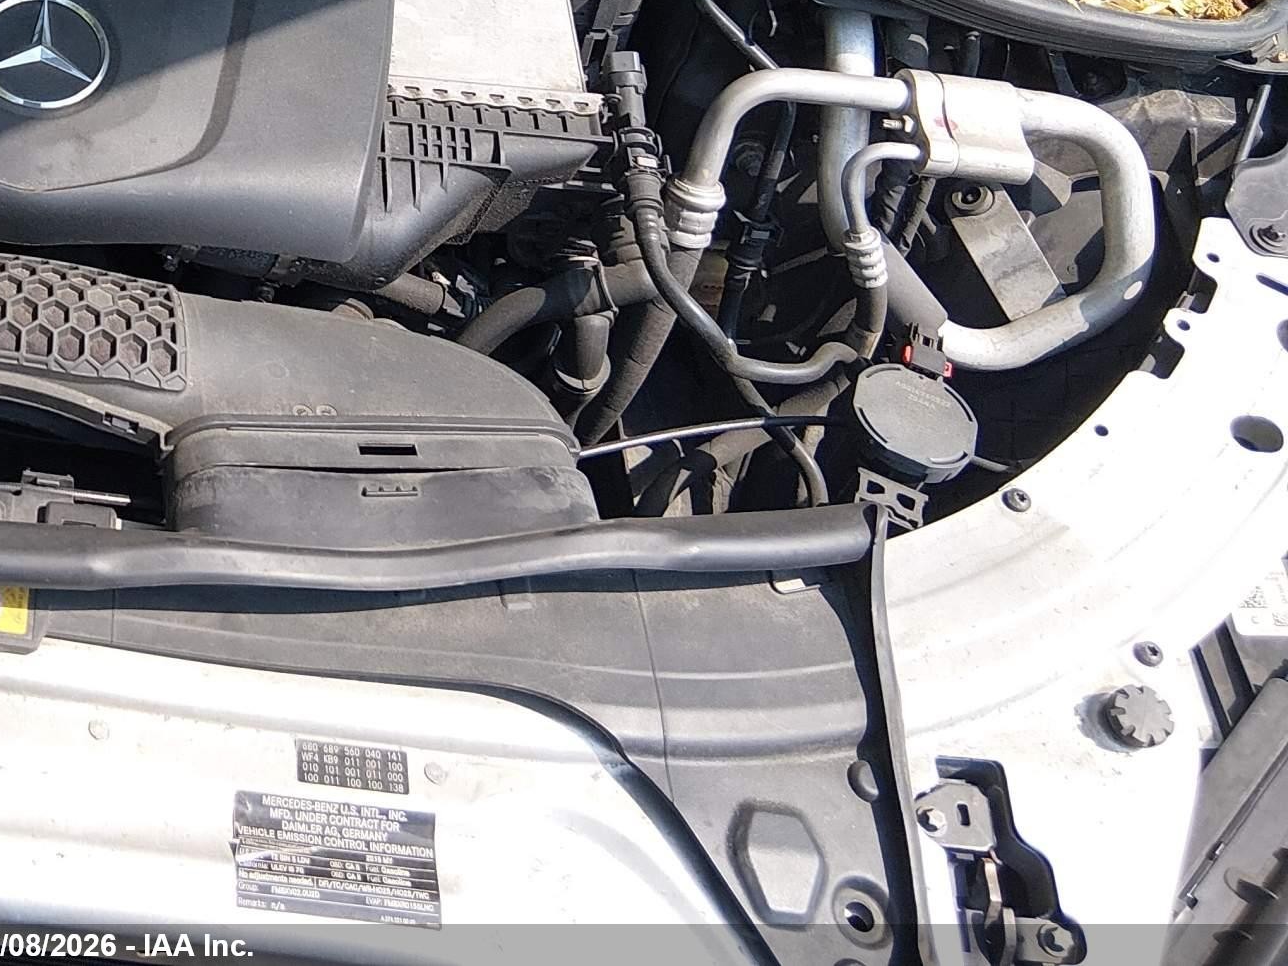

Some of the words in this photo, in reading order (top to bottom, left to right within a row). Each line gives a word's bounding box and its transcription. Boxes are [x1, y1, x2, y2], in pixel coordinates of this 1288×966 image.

[344, 757, 360, 766] 011
[365, 759, 381, 769] 001
[388, 762, 403, 771] 100
[365, 749, 381, 759] 040
[302, 762, 319, 772] 010
[324, 765, 339, 775] 101
[344, 767, 360, 777] 001
[365, 770, 381, 779] 011
[387, 772, 403, 782] 000
[304, 772, 319, 782] 100
[323, 775, 339, 785] 011
[346, 778, 362, 787] 100
[367, 780, 383, 790] 100
[262, 795, 339, 813] MERCEDES-BENZ
[388, 810, 408, 822] INC.
[269, 807, 294, 820] MFD.
[295, 811, 328, 824] UNDER
[329, 814, 379, 830] CONTRACT
[381, 821, 400, 833] FOR
[237, 825, 275, 838] VEHICLE
[277, 830, 322, 845] EMISSION
[323, 836, 368, 851] CONTROL
[369, 841, 434, 858] INFORMATION
[281, 820, 322, 835] DAIMLER
[342, 827, 388, 842] GERMANY
